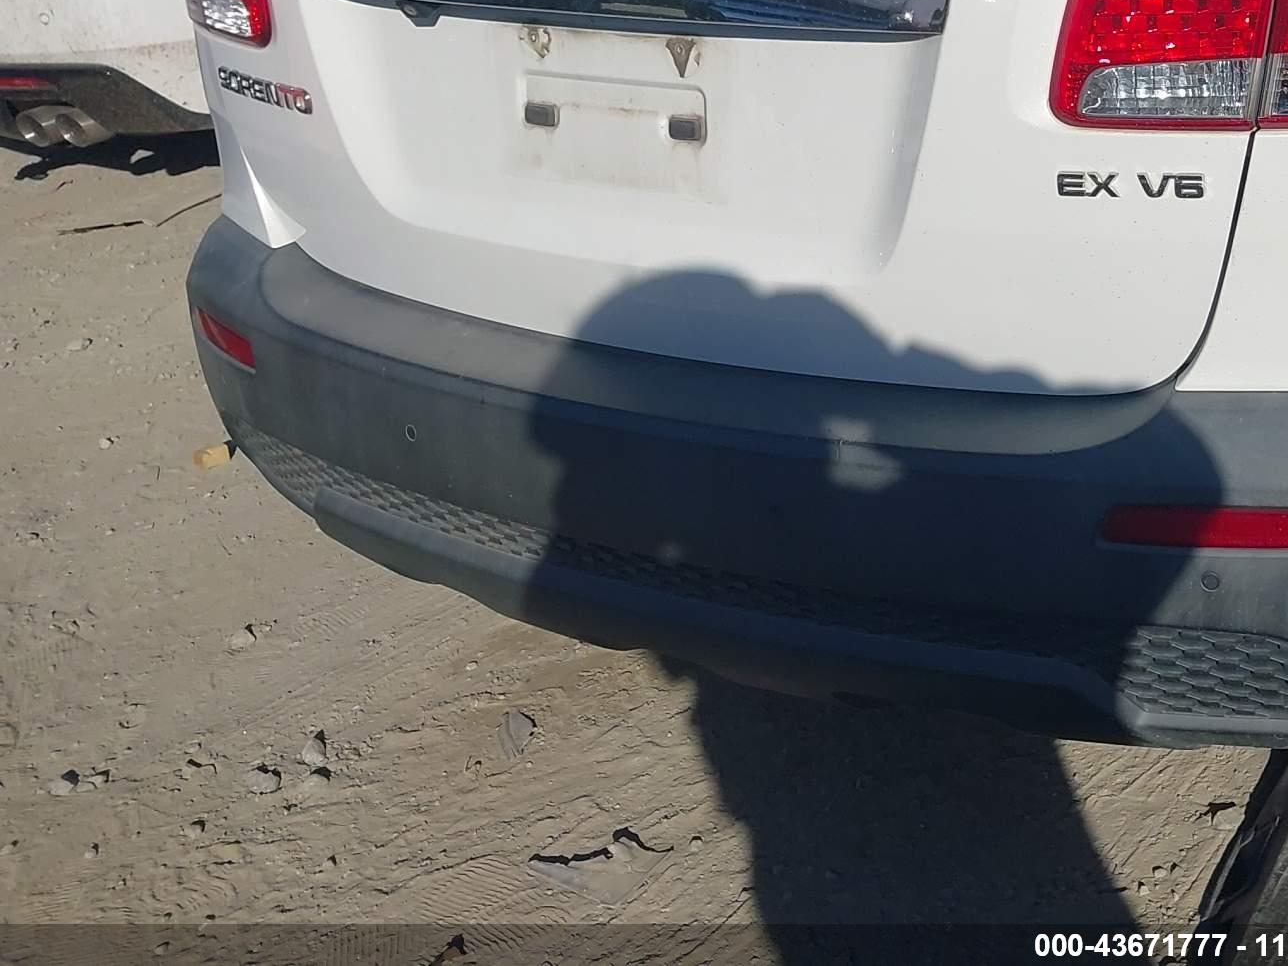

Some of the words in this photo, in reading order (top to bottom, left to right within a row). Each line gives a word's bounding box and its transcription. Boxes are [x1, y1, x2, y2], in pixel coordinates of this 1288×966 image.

[218, 65, 313, 115] SORENTO
[1056, 171, 1120, 198] EX
[1136, 172, 1205, 199] V6
